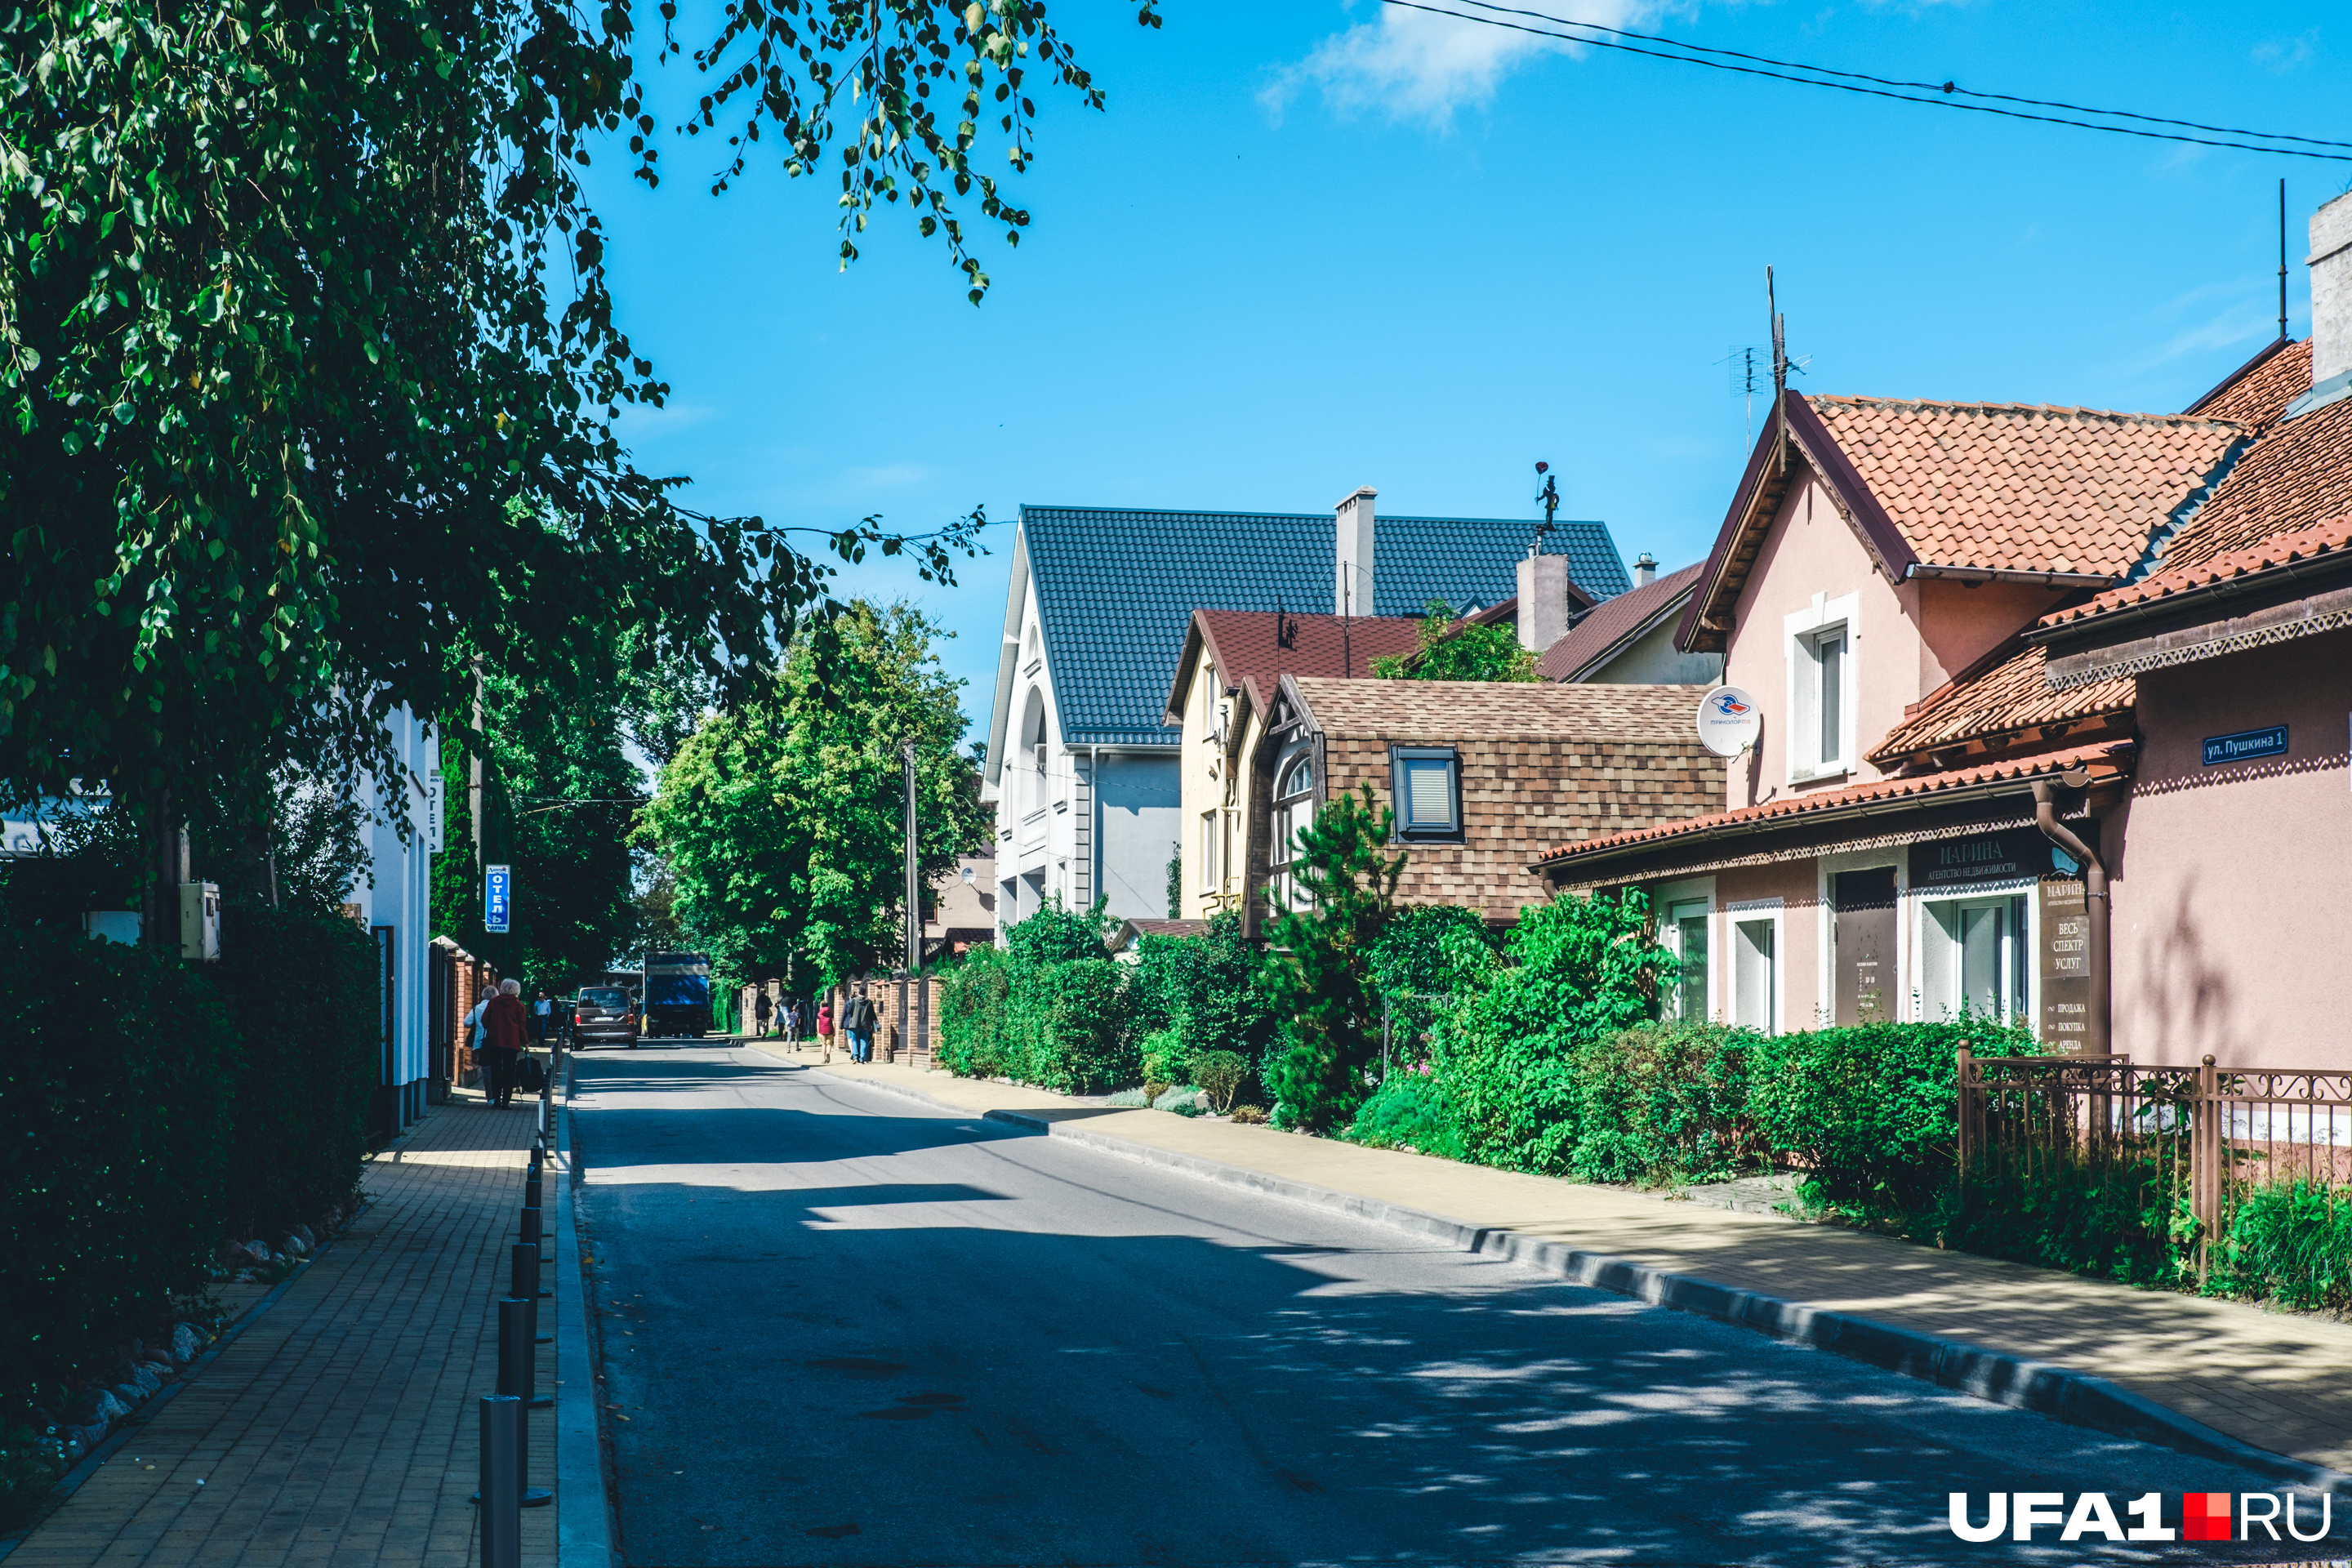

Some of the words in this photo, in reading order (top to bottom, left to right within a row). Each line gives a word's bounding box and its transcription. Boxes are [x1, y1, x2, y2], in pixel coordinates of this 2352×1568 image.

[2207, 745, 2223, 760] ул.
[2225, 736, 2274, 755] Пушкина
[2276, 732, 2283, 745] 1
[1940, 840, 2004, 865] МАРИНА
[1928, 867, 1962, 880] АГЕНТСТВО
[1962, 862, 2016, 879] НЕДВИЖИМОСТИ
[492, 875, 503, 924] ОТЕЛЬ
[2058, 922, 2078, 935] ВЕСЬ
[2053, 939, 2083, 952] СПЕКТР
[2055, 957, 2082, 970] УСЛУГ
[2057, 1003, 2086, 1014] ПРОДАЖА
[2058, 1022, 2086, 1031] ПОКУПКА
[2058, 1040, 2082, 1051] АРЕНДА
